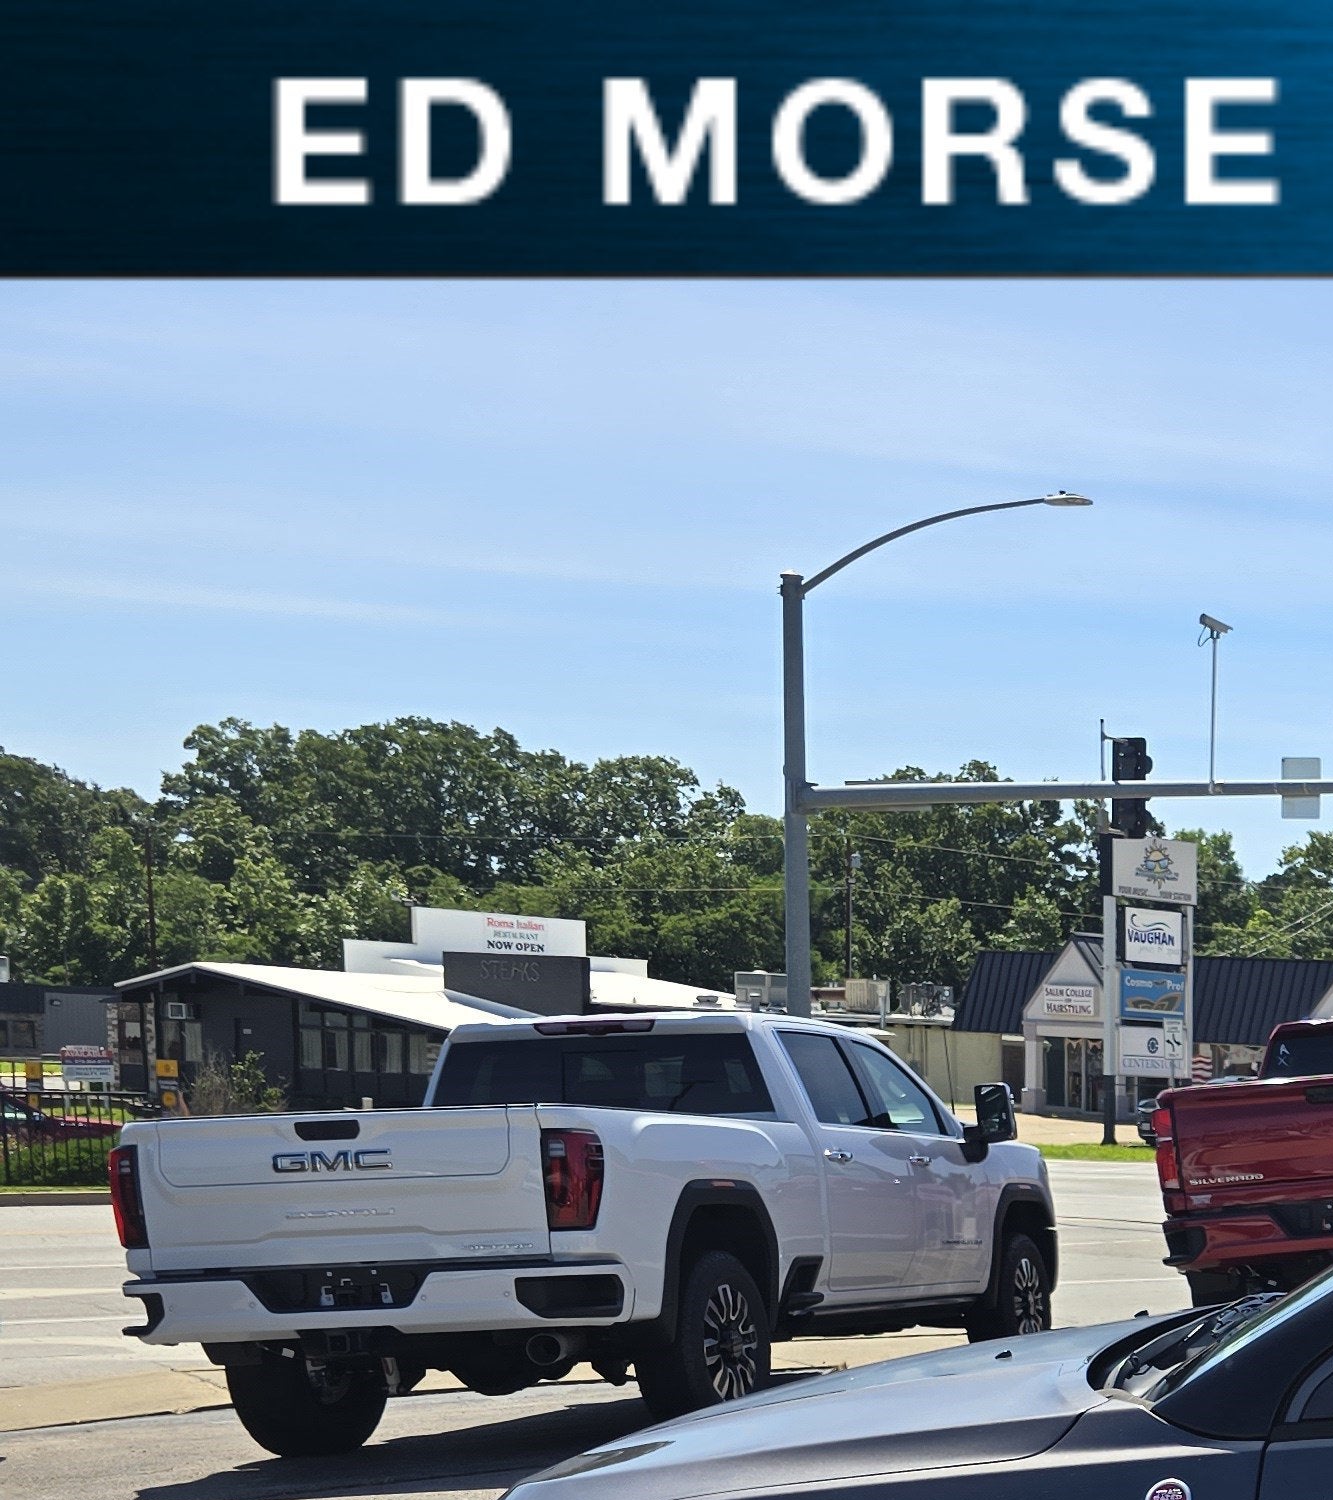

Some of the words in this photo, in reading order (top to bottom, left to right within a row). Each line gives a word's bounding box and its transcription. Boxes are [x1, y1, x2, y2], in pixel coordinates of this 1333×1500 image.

[1127, 929, 1175, 946] VAUGHAN
[486, 940, 514, 950] NOW
[515, 942, 545, 952] OPEN
[1166, 980, 1185, 991] Prof
[1046, 1003, 1092, 1014] HAIRSTYLING
[272, 1148, 393, 1173] GMC
[1189, 1173, 1264, 1186] SILVERADO
